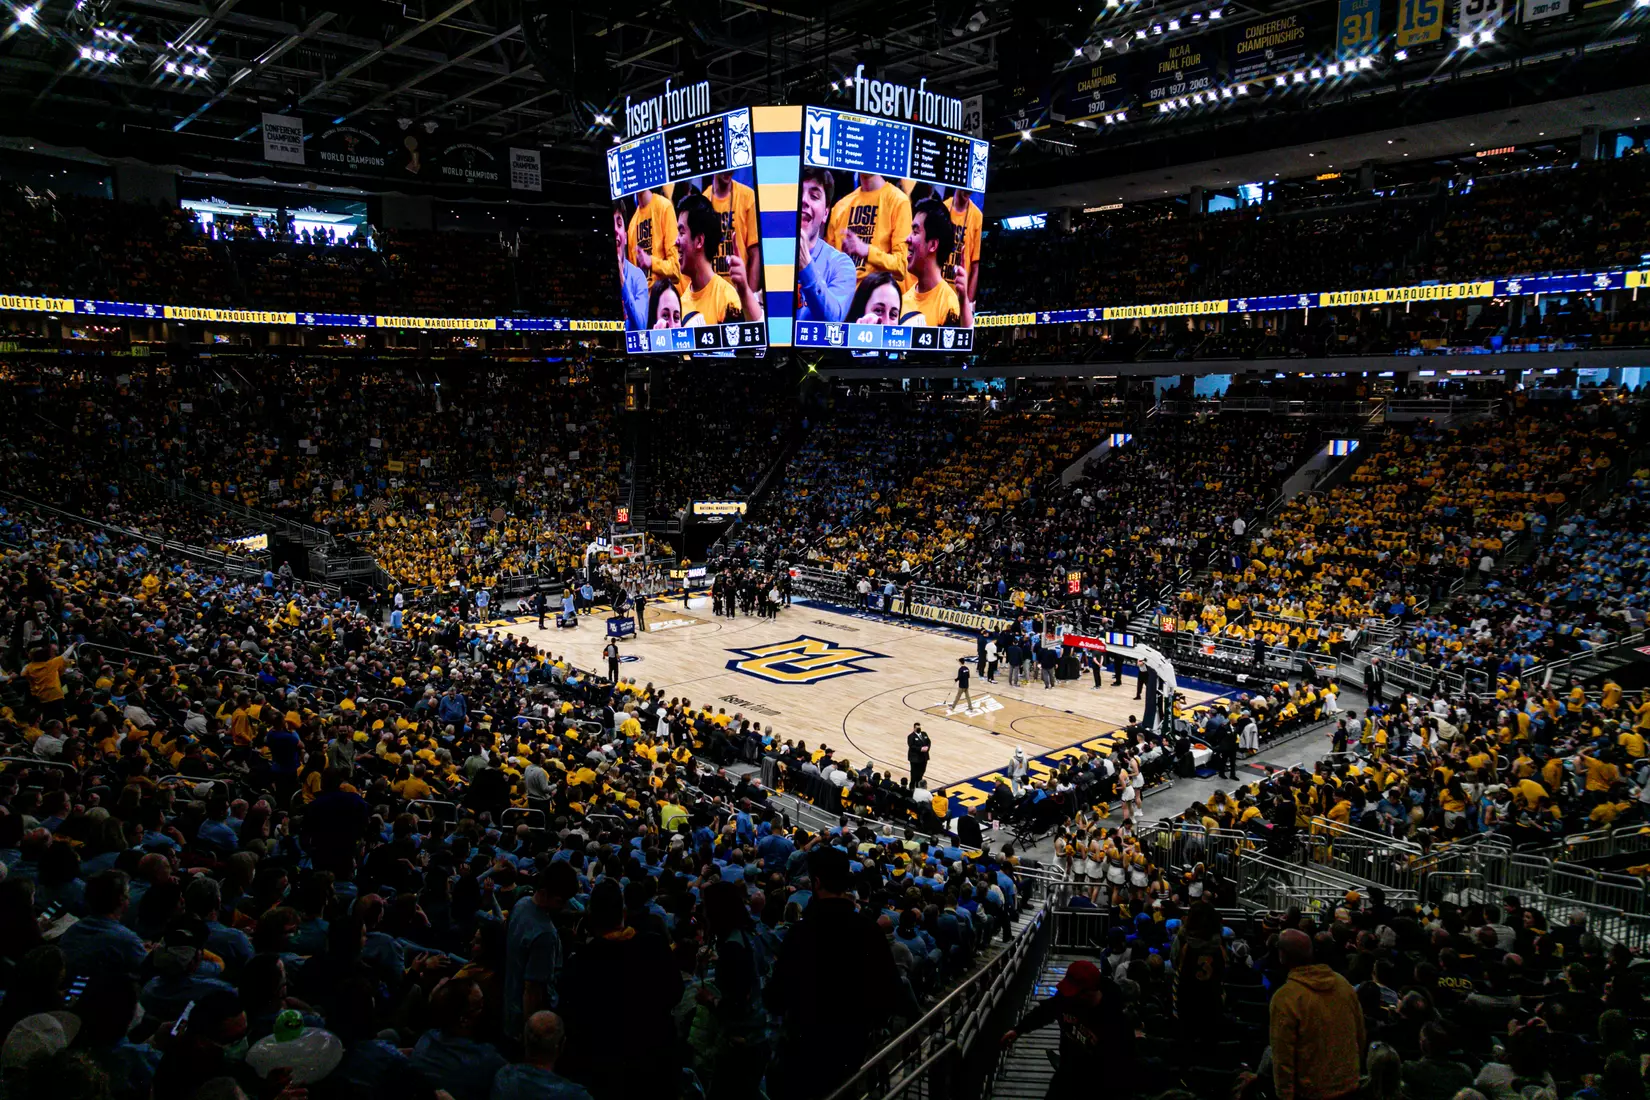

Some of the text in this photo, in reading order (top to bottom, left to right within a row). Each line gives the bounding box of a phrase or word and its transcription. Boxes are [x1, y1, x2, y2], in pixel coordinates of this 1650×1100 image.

[1246, 15, 1298, 39] CONFERENCE
[1342, 11, 1374, 46] 31
[1237, 27, 1305, 54] CHAMPIONSHIPS
[1169, 44, 1190, 58] NCAA
[1158, 53, 1201, 73] FINAL FOUR
[1078, 73, 1116, 92] CHAMPIONS
[1150, 77, 1208, 99] 1974 1977 2003
[1088, 100, 1105, 113] 1970
[964, 112, 980, 130] 43
[265, 124, 301, 136] CONFERENCE
[267, 132, 300, 144] CHAMPIONS
[320, 151, 384, 166] WORLD CHAMPIONS
[513, 161, 538, 170] CHAMPIONS
[442, 166, 498, 180] WORLD CHAMPIONS
[850, 206, 878, 226] LOSE
[1329, 285, 1482, 304] NATIONAL MARQUETTE DAY
[46, 300, 65, 310] DAY
[1110, 302, 1219, 318] NATIONAL MARQUETTE DAY
[172, 308, 288, 322] NATIONAL MARQUETTE DAY
[975, 315, 1029, 326] MARQUETTE DAY
[384, 317, 489, 328] NATIONAL MARQUETTE DAY
[577, 321, 614, 330] NATIONAL
[656, 336, 666, 346] 40
[701, 333, 714, 344] 43
[858, 331, 873, 343] 40
[919, 333, 932, 345] 43
[618, 513, 627, 522] 30
[1069, 580, 1080, 593] 30
[898, 601, 1006, 630] NIONAL MARQUETTE DAY
[1164, 623, 1172, 632] 30
[1195, 956, 1213, 981] 3
